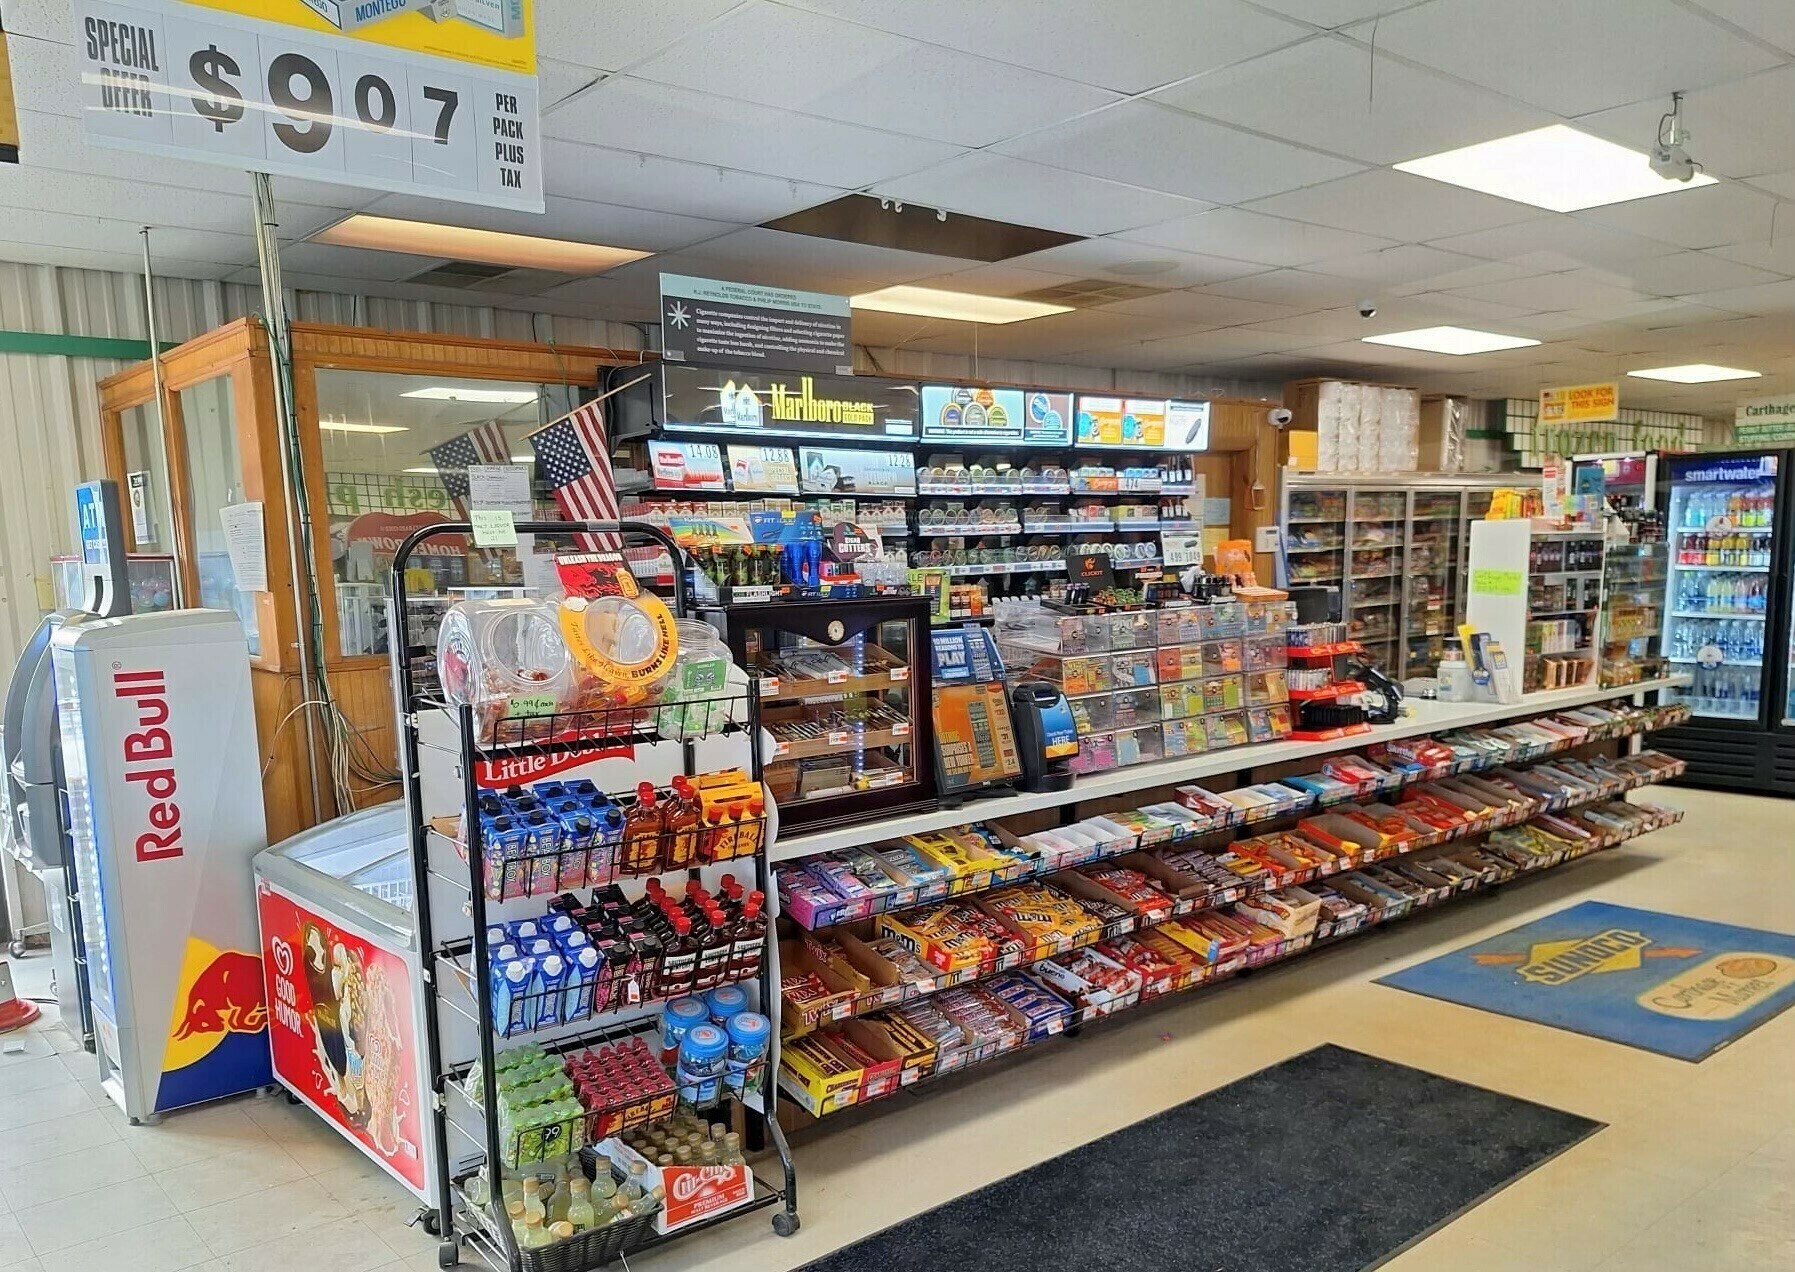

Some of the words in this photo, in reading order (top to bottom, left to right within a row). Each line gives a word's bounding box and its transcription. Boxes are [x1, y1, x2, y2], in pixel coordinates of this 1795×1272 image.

[85, 16, 159, 72] SPECIAL
[100, 69, 153, 118] OFFER
[495, 92, 518, 114] PER
[492, 116, 524, 141] PACK
[495, 141, 524, 165] PLUS
[499, 167, 522, 189] TAX
[771, 377, 842, 423] Marlboro
[1569, 388, 1592, 400] LOOK
[1594, 386, 1614, 397] FOR
[1571, 398, 1591, 409] THIS
[1593, 396, 1615, 408] SIGN
[842, 402, 873, 412] BLACK
[558, 554, 587, 566] UNLEASH
[599, 552, 623, 562] DRAGON
[838, 543, 870, 554] CUTTERS
[940, 636, 964, 646] MILLION
[631, 657, 663, 679] BURNS
[660, 638, 670, 660] LIKE
[937, 651, 966, 667] PLAY
[113, 670, 174, 763] Bull
[1052, 735, 1070, 746] HERE
[485, 754, 546, 781] Little
[125, 770, 184, 863] Red
[719, 831, 760, 850] FIRBALL
[1525, 931, 1647, 982] SUNOCO
[1039, 964, 1065, 980] bueno
[275, 973, 297, 1007] GOOD
[274, 997, 302, 1038] HUMOR
